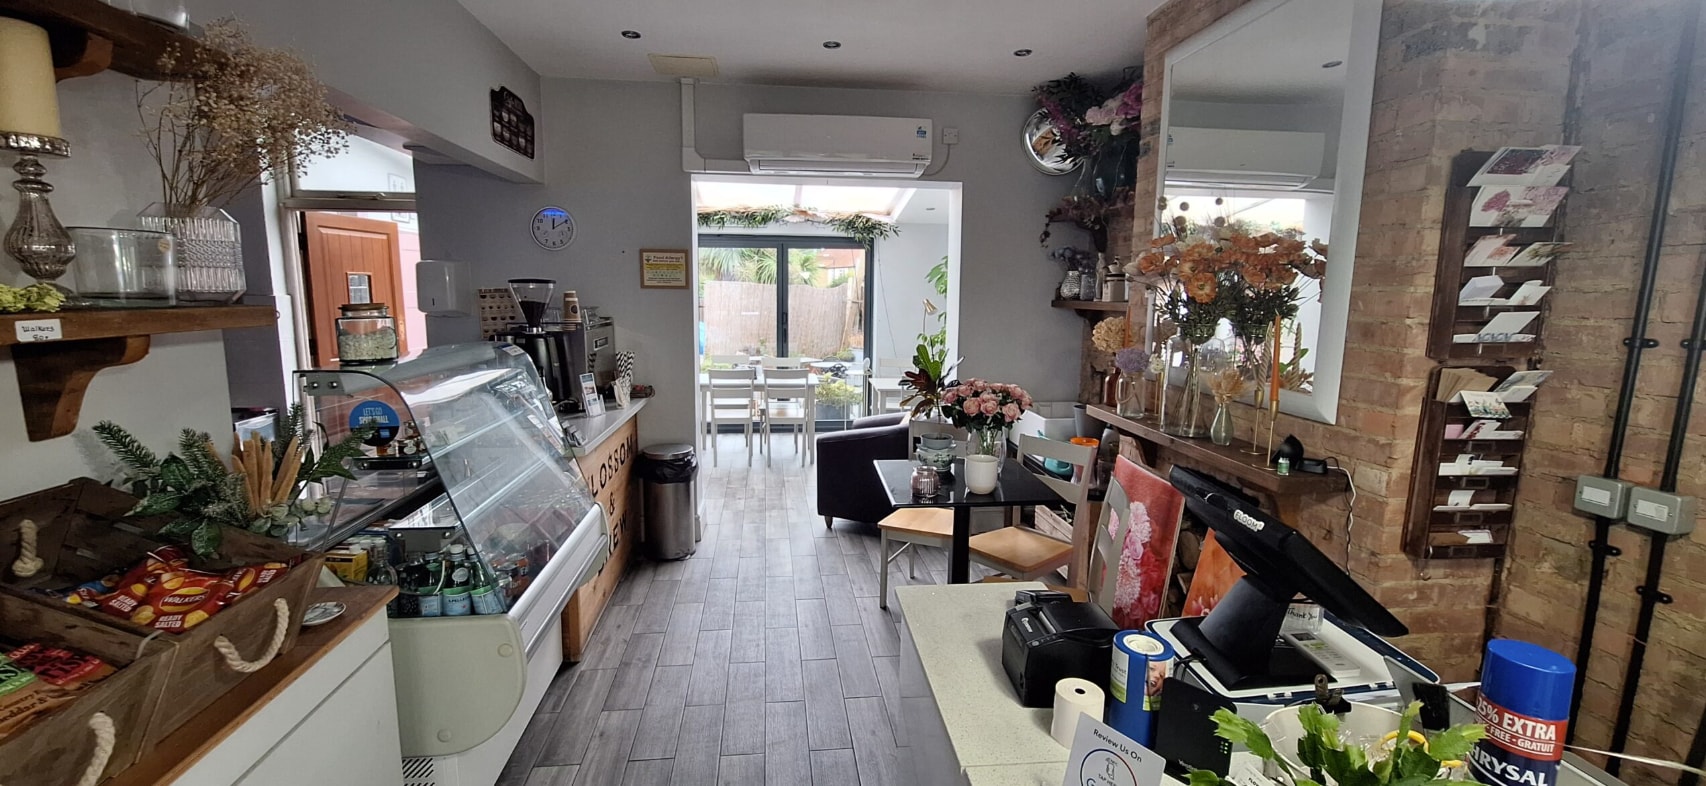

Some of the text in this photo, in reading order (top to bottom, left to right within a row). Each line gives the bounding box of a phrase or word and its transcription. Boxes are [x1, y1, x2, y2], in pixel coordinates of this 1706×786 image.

[588, 433, 634, 498] LOSSOM
[608, 492, 616, 517] &
[1234, 511, 1259, 529] FLOOM
[108, 599, 134, 613] SALTED
[116, 594, 139, 608] READY
[162, 592, 207, 605] WALKERS
[158, 614, 184, 622] READY
[1287, 607, 1306, 619] Thank
[154, 620, 182, 629] SALTED
[1503, 712, 1556, 740] EXTRA
[1093, 728, 1142, 762] Review Us On
[1490, 726, 1511, 742] FREE
[1517, 738, 1555, 753] GRATUIT
[1471, 743, 1548, 786] HRYSAL
